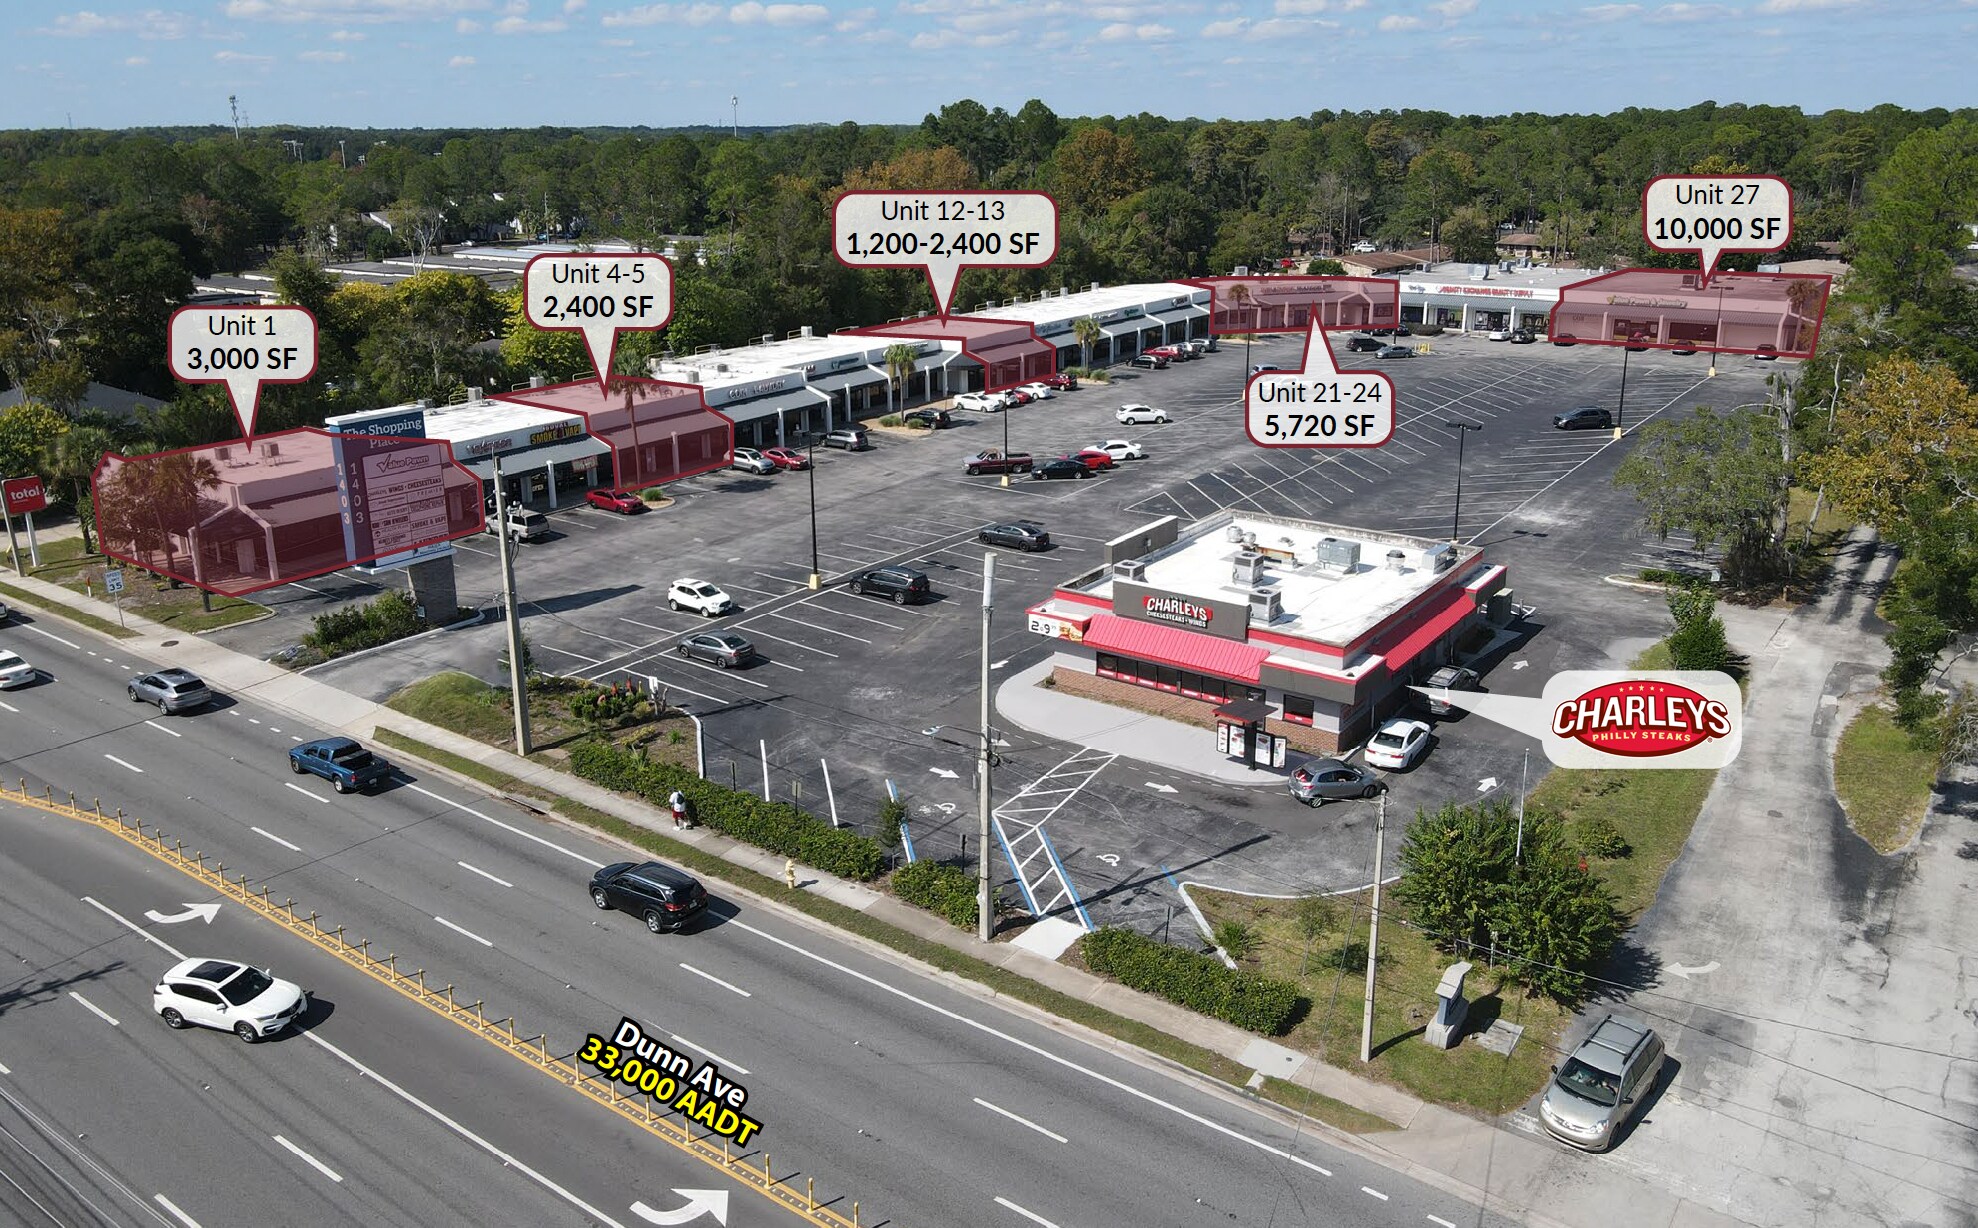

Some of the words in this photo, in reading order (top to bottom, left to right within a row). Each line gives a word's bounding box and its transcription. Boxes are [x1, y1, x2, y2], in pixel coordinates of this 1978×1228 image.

[343, 428, 366, 441] The
[368, 419, 423, 436] Shopping
[531, 430, 557, 444] SMOKE
[369, 436, 401, 448] Place
[377, 453, 405, 473] Value
[405, 455, 430, 467] Pawn
[10, 485, 40, 500] total
[388, 485, 404, 493] WINGS
[109, 582, 122, 591] 35
[1146, 597, 1208, 622] CHARLEYS
[1188, 616, 1207, 628] WINGS
